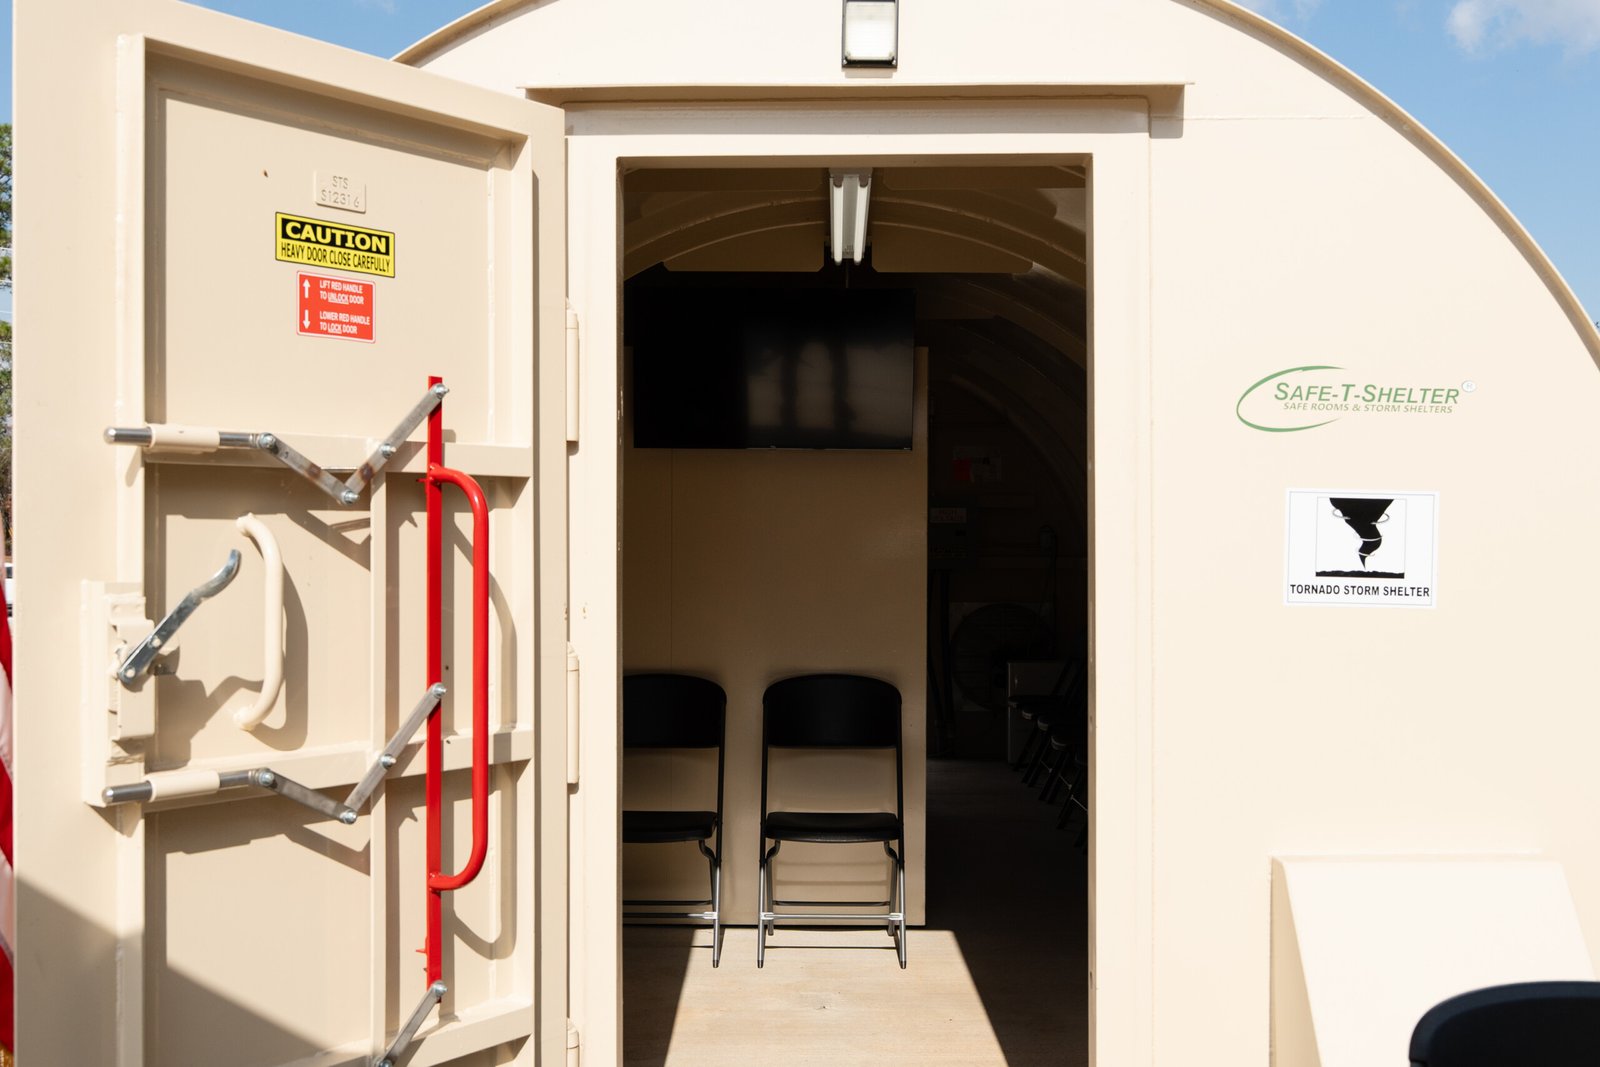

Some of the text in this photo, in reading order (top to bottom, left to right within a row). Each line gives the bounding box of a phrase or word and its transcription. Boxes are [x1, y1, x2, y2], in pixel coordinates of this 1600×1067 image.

[332, 175, 349, 189] STS
[285, 221, 386, 253] CAUTION
[281, 242, 391, 273] HEAVY DOOR CLOSE CAREFULLY
[320, 280, 363, 294] LIFT RED HANDLE
[320, 291, 364, 304] TO UNLOCK DOOR
[320, 311, 370, 325] LOWER RED HANDLE
[320, 322, 358, 334] TO LOCK DOOR
[1283, 402, 1453, 414] SAFE ROOMS & STORM SHELTERS
[1290, 584, 1430, 597] TORNADO STORM SHELTER
